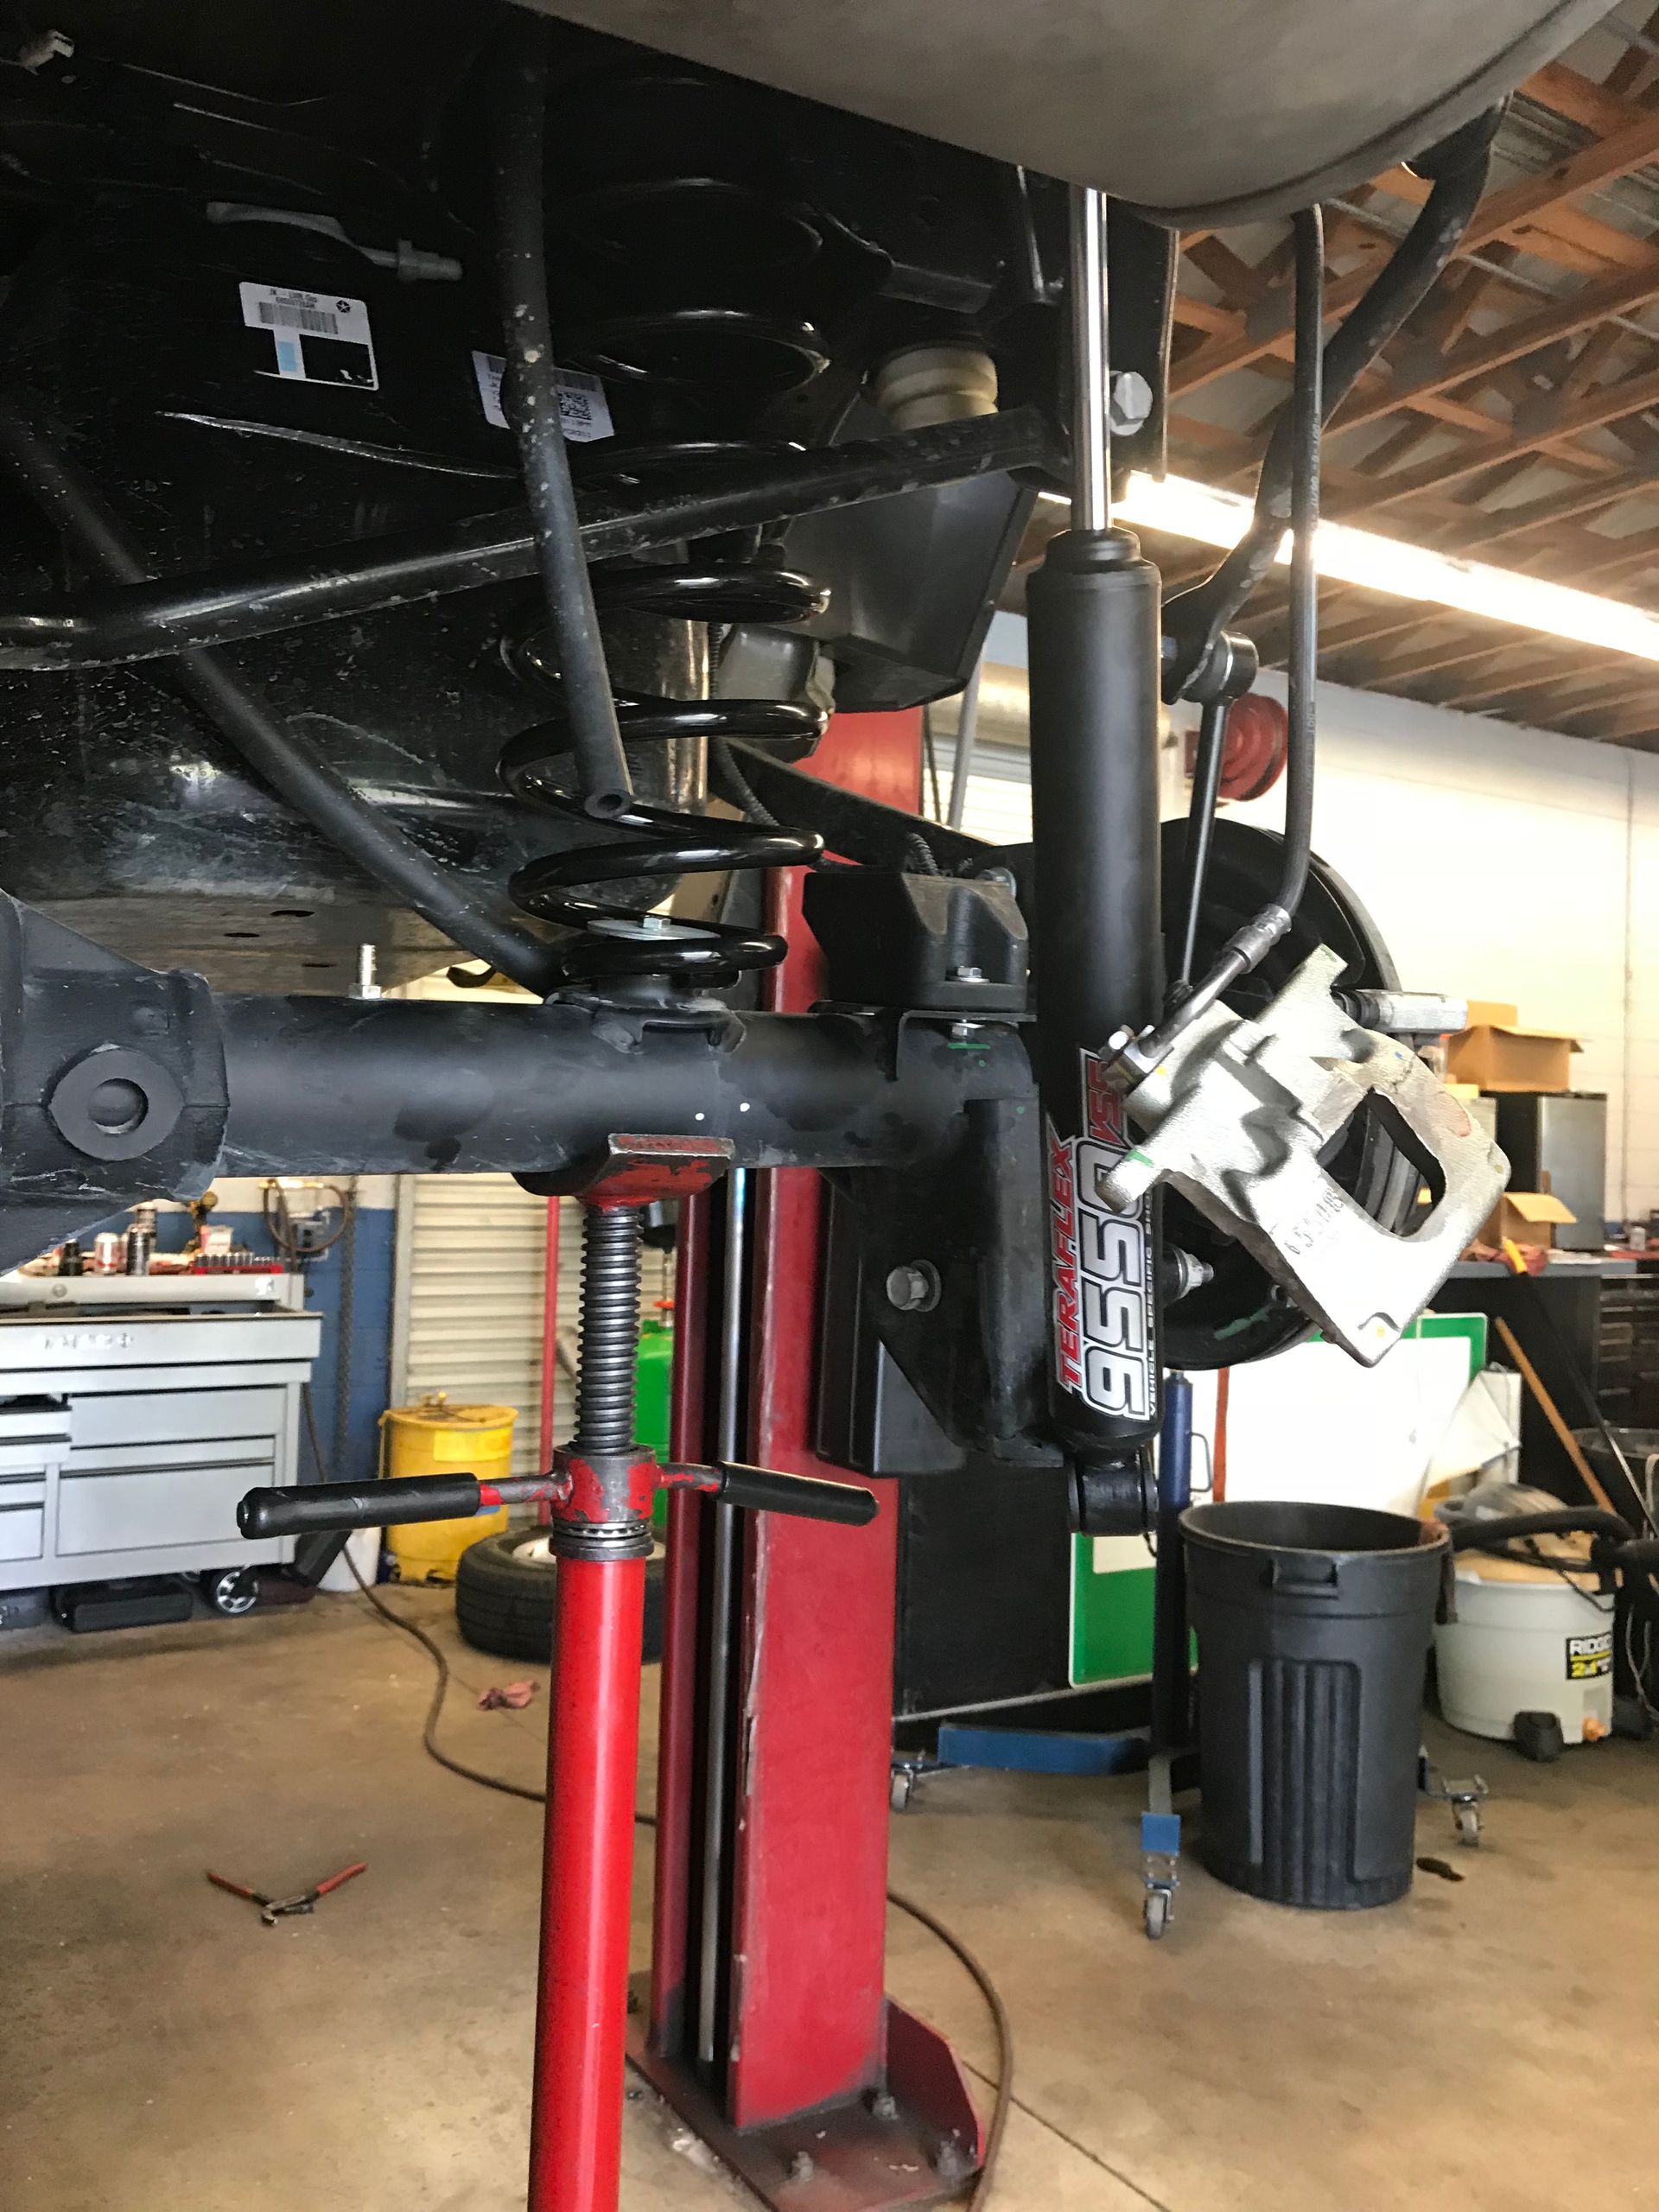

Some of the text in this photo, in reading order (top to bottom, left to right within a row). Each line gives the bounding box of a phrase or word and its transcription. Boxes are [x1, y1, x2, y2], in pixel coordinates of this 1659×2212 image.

[1046, 1134, 1083, 1390] TERAFLEX
[1078, 1141, 1147, 1417] 9550
[1145, 1246, 1155, 1329] SPECIFIC
[1147, 1339, 1157, 1416] VEHICLE
